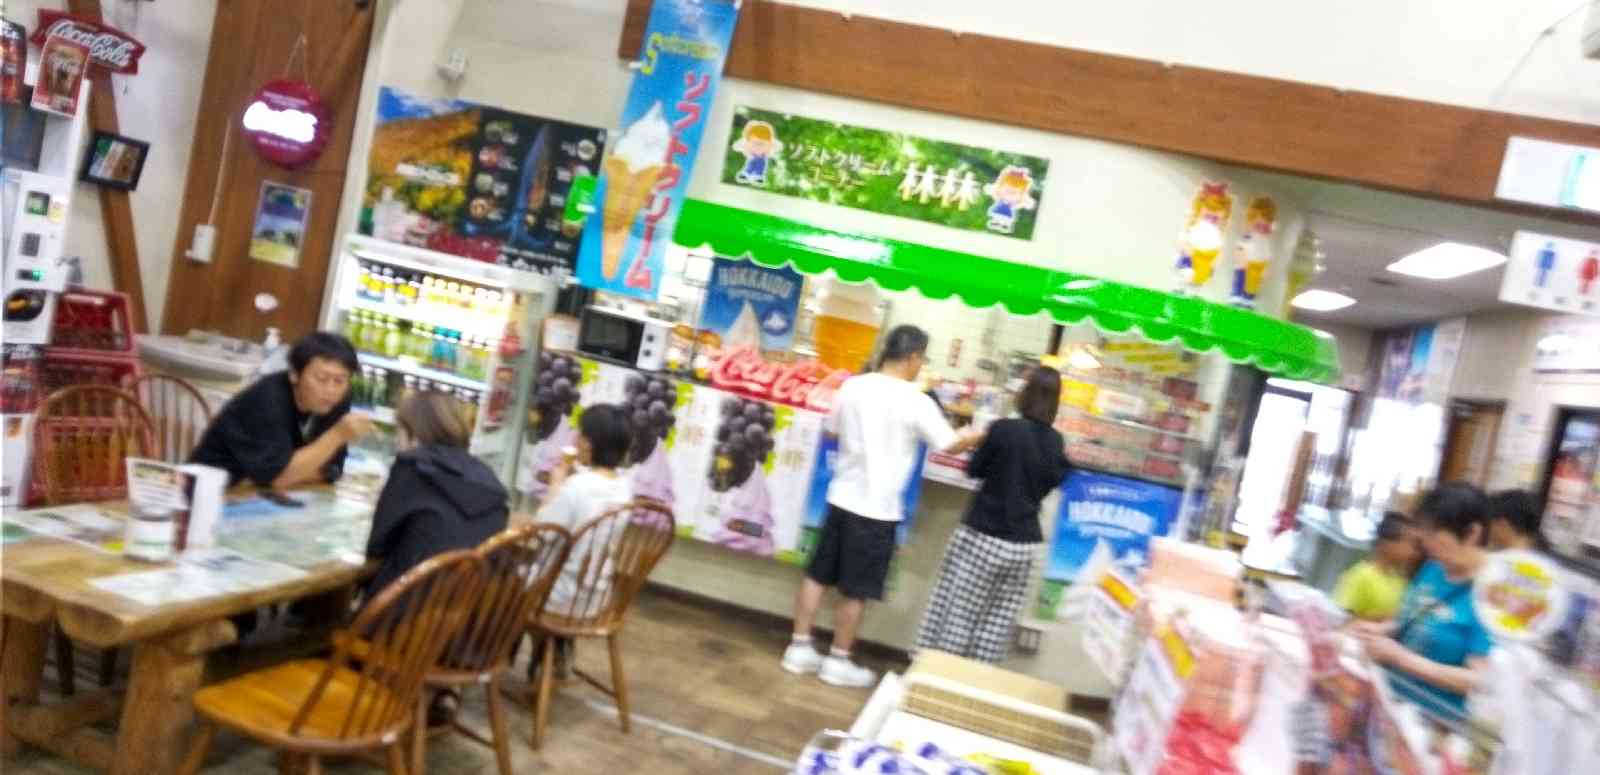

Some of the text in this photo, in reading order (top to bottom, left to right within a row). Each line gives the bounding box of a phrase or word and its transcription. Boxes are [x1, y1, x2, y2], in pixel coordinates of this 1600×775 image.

[623, 72, 711, 289] ソフトクリーム
[896, 160, 982, 212] 林林
[717, 266, 797, 300] HOKKAIDO
[711, 345, 851, 409] Coca-Col
